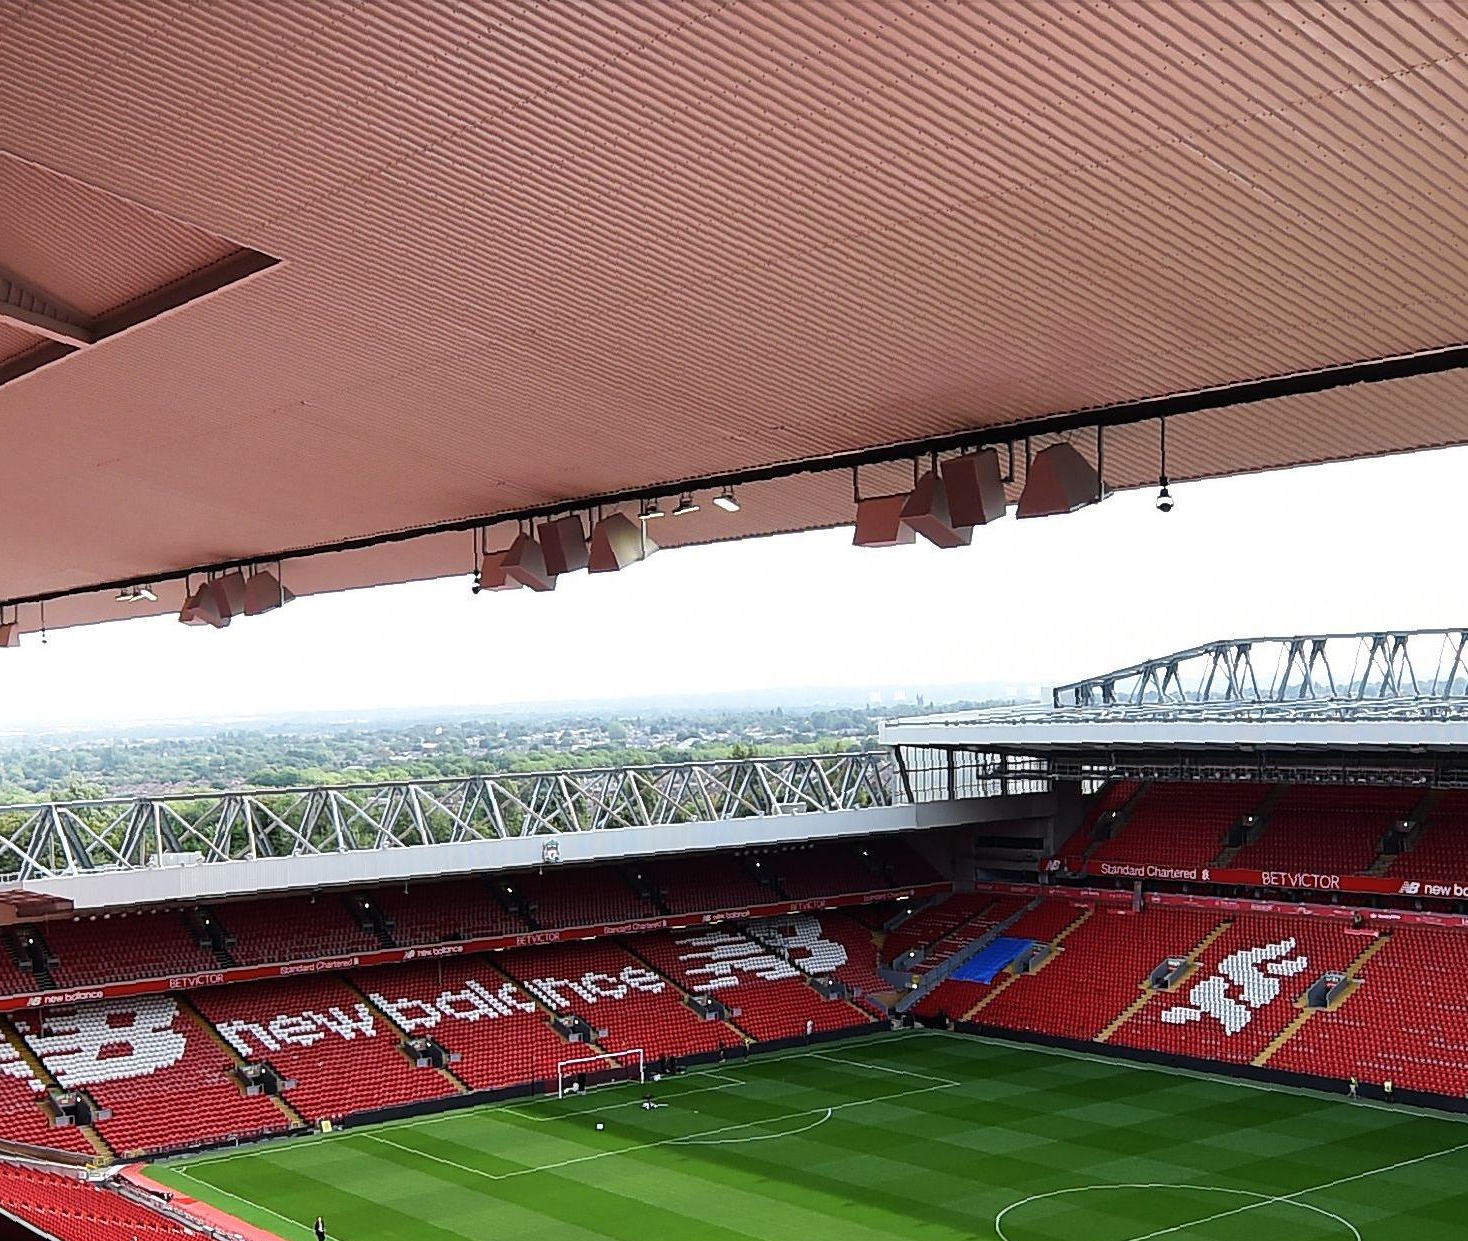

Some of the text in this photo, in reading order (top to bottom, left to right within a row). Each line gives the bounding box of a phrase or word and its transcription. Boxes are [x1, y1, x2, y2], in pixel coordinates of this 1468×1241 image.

[1100, 862, 1197, 881] Standard Chartered
[1260, 871, 1340, 890] BETVICTOR
[1423, 883, 1451, 897] new
[279, 957, 353, 975] Standard Chartered
[169, 973, 225, 989] BETVICTOR
[43, 993, 64, 1005] new
[64, 989, 104, 1002] balance
[216, 1001, 378, 1057] new
[368, 965, 667, 1033] balance
